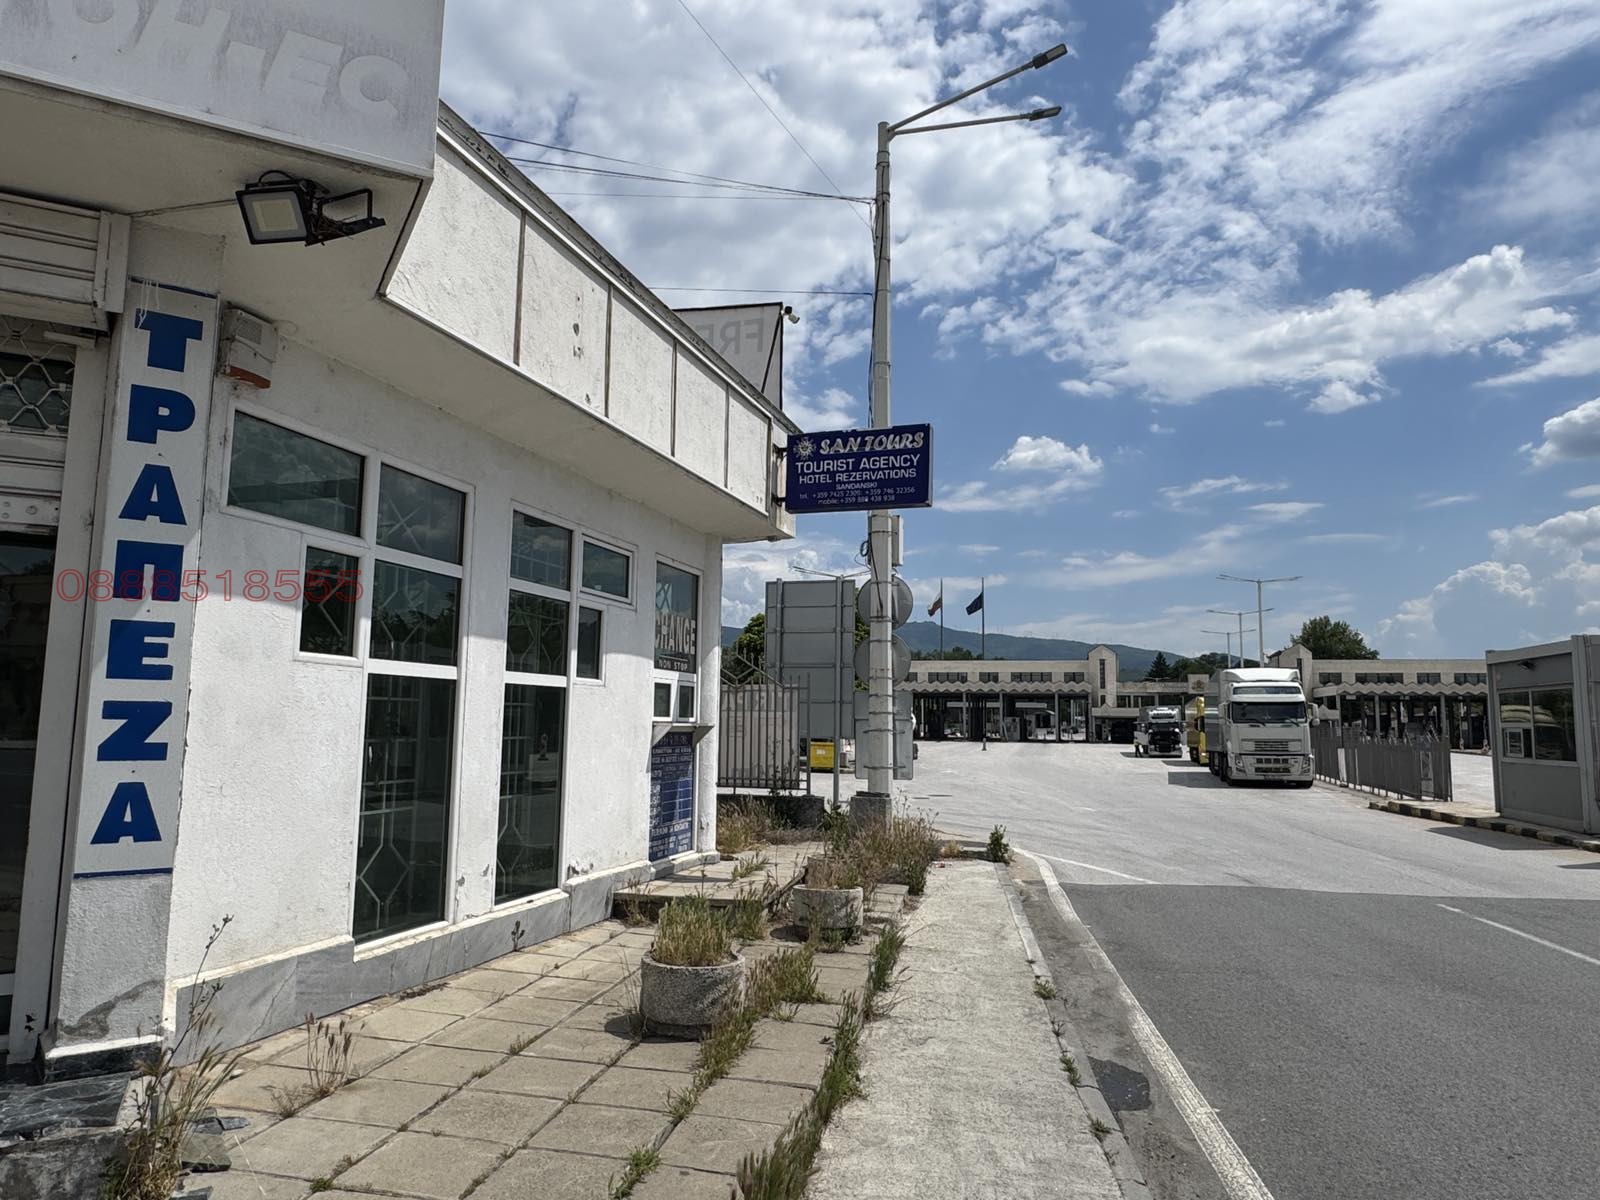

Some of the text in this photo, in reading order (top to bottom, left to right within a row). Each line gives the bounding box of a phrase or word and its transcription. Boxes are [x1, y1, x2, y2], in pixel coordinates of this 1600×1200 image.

[820, 431, 925, 455] SAN TOURS
[795, 453, 921, 474] TOURIST AGENCY
[799, 468, 917, 484] HOTEL REZERVATIONS
[835, 481, 878, 490] SANDANSKI
[655, 613, 696, 655] CHANGE
[673, 661, 688, 671] STOP
